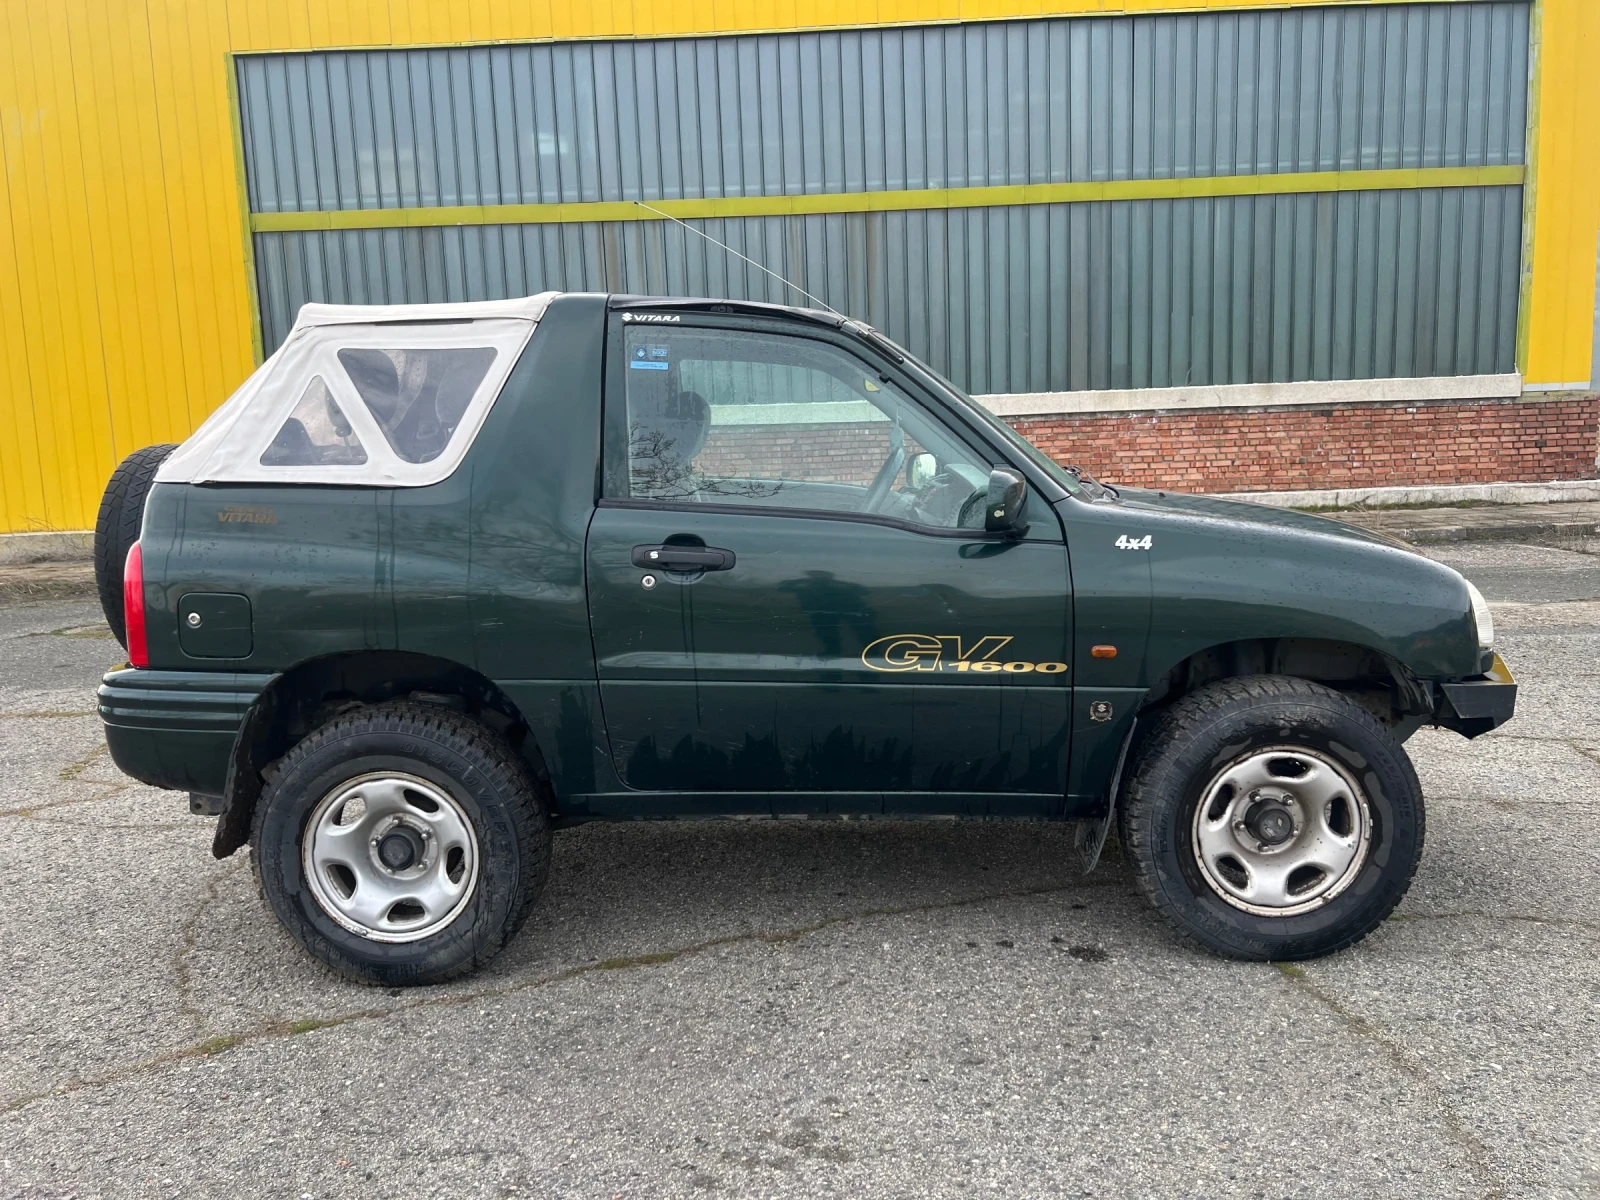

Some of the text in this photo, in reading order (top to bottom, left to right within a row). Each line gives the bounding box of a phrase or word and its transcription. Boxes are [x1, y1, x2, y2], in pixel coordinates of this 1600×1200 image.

[634, 314, 681, 322] VITARA
[217, 512, 278, 524] VITARA
[1114, 534, 1153, 550] 4x4
[861, 633, 1015, 672] GV
[948, 661, 1068, 673] 1600
